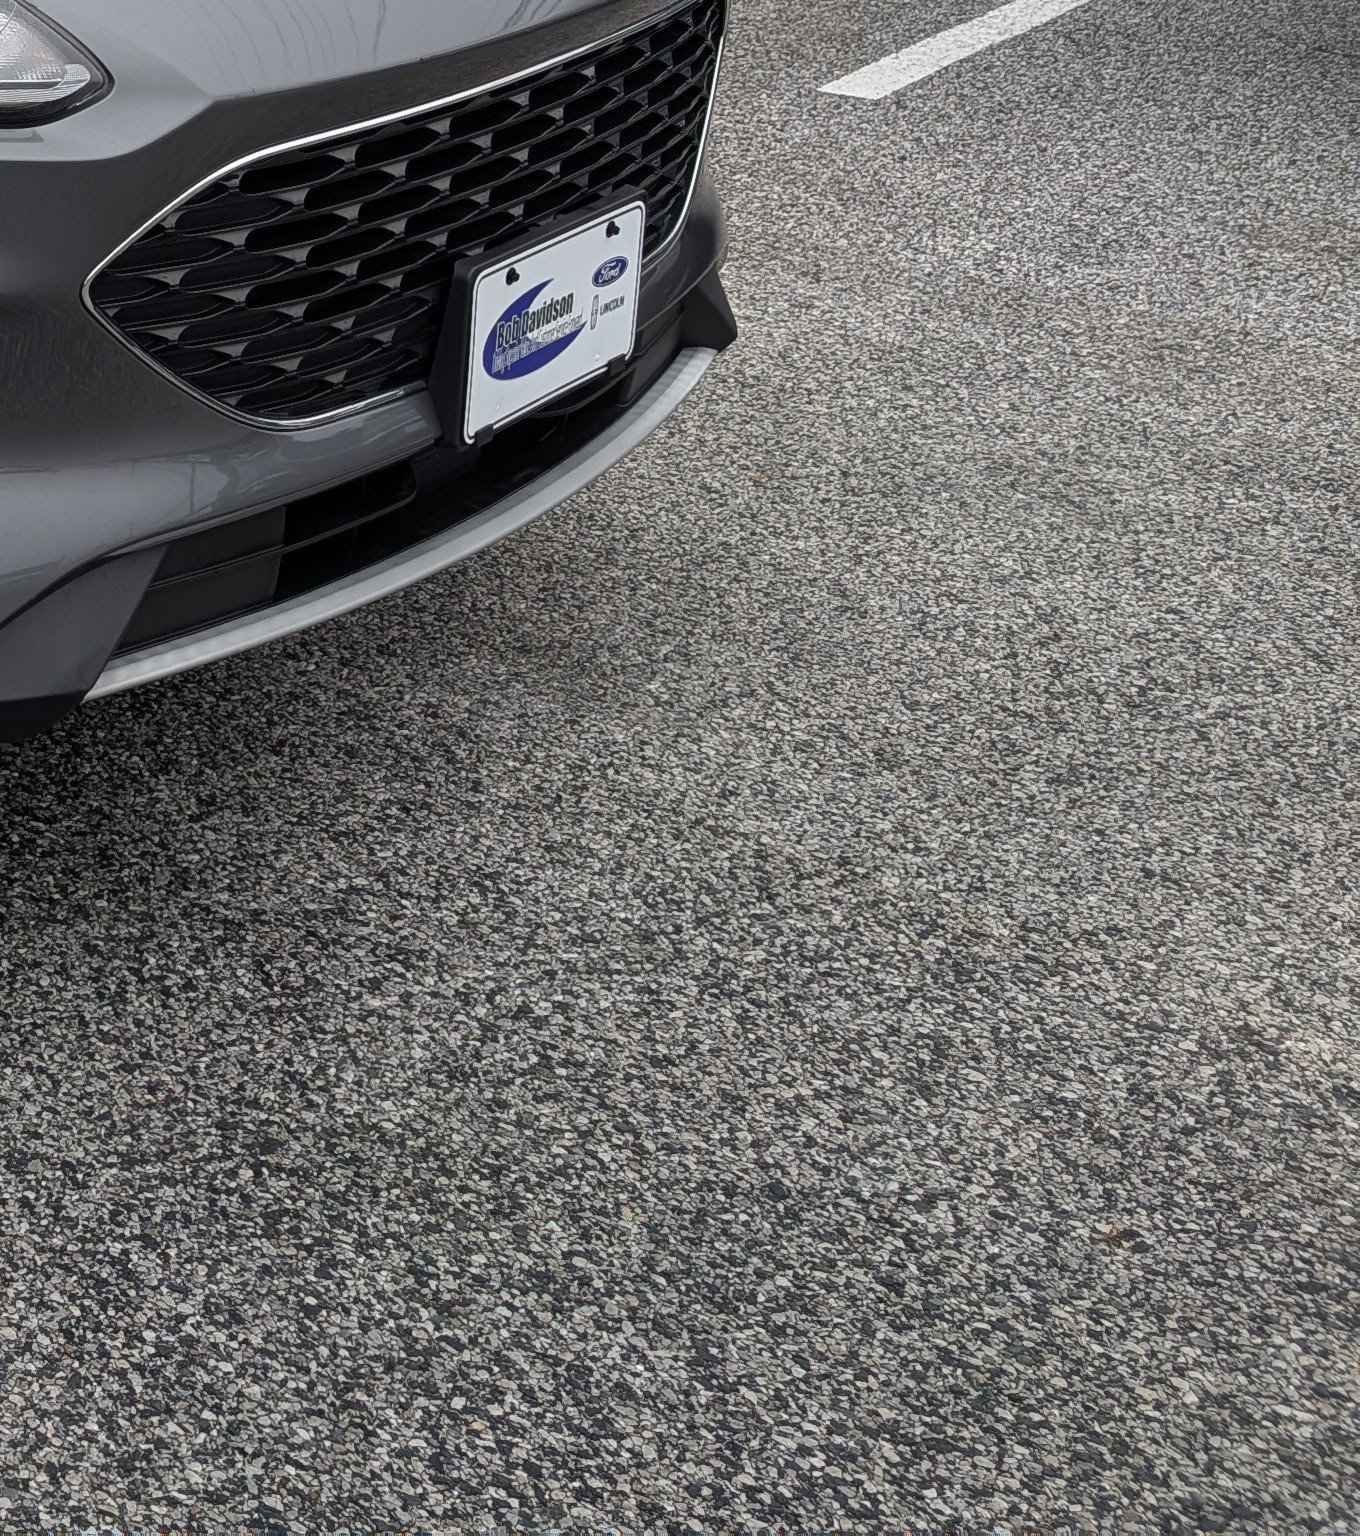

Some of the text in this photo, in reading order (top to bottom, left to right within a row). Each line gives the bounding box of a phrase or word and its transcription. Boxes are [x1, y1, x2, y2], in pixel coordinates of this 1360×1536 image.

[598, 261, 622, 283] Ford
[600, 295, 625, 315] LINCOLN
[496, 315, 520, 350] Bob
[520, 292, 574, 338] Davidson
